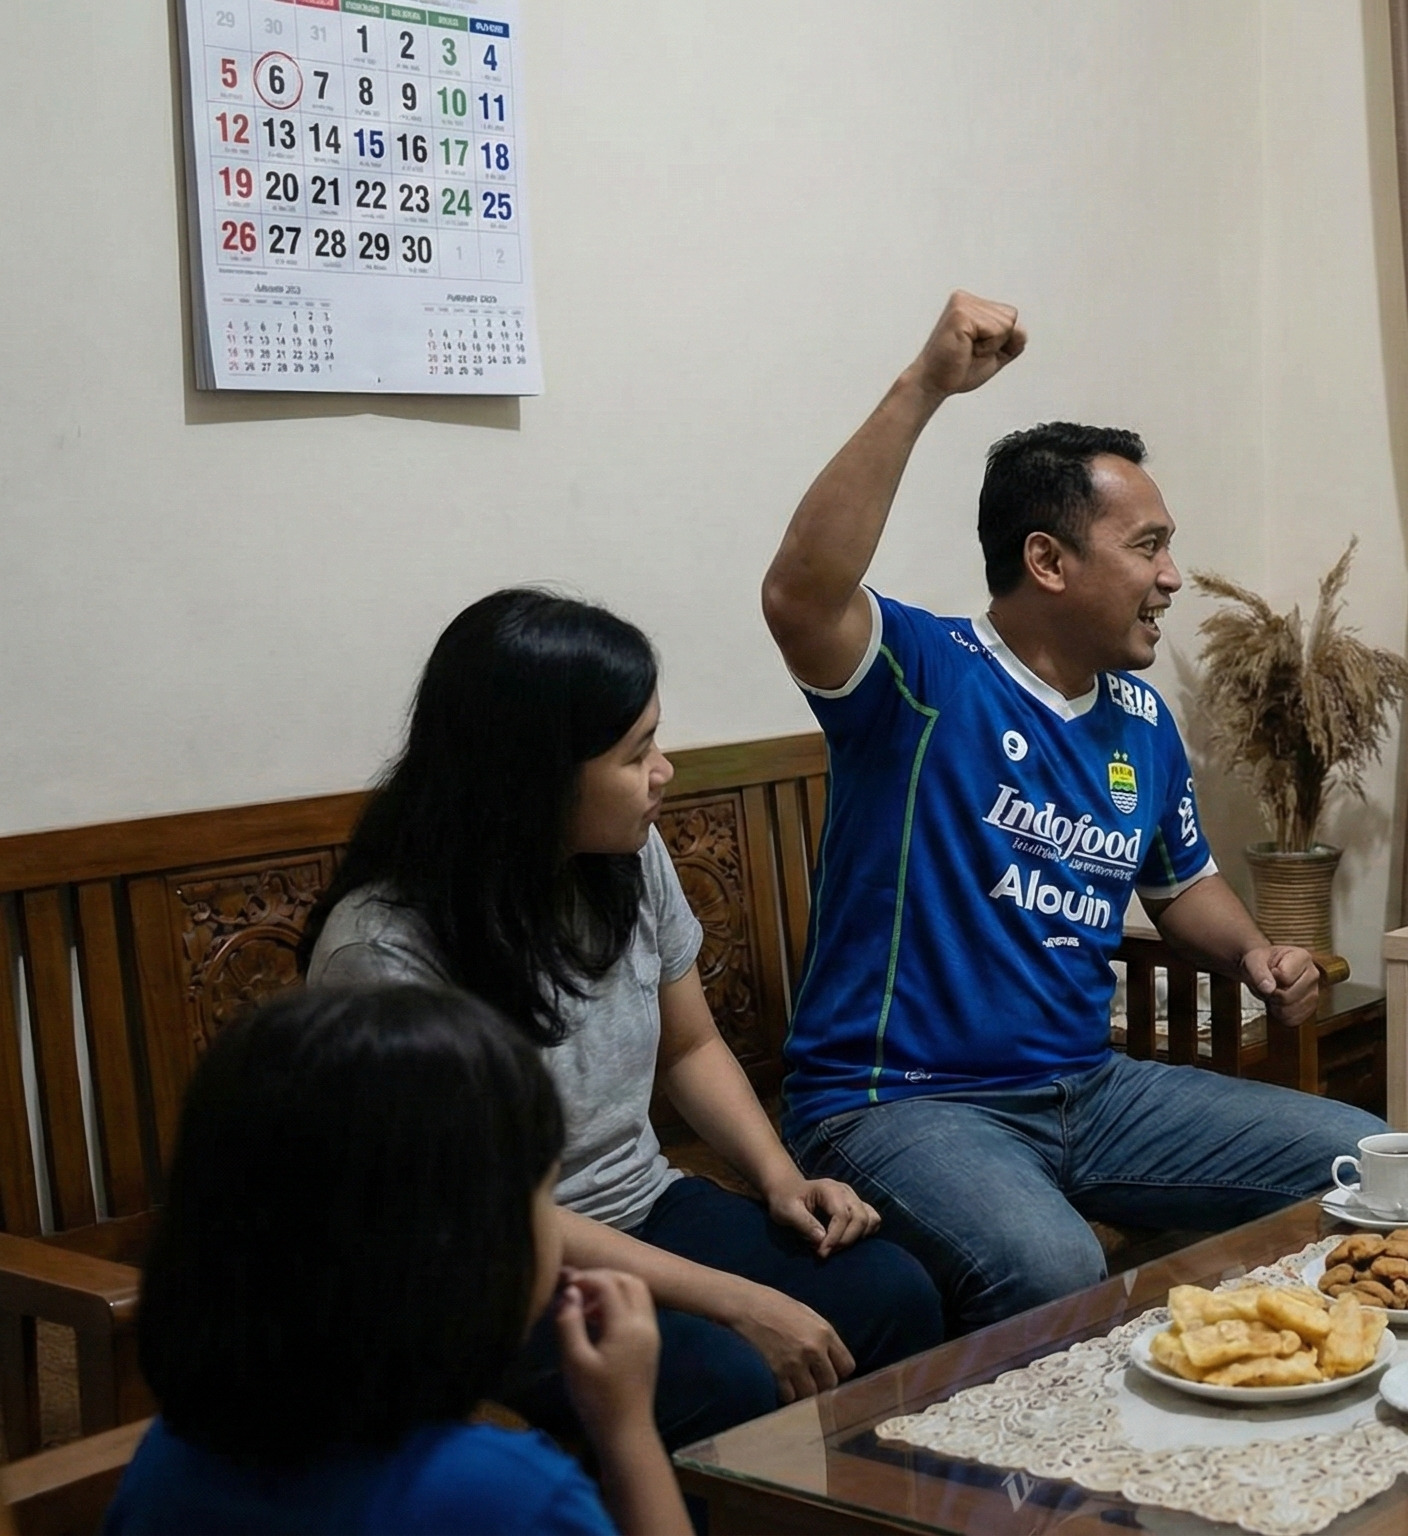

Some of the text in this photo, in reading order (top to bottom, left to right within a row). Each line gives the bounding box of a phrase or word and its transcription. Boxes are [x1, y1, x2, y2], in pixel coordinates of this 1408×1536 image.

[216, 11, 497, 70] 29 30 31 1 2 3 4
[221, 58, 505, 121] 5 6 7 8 9 10 11
[215, 111, 509, 171] 12 13 14 15 16 17 18
[219, 167, 512, 220] 19 20 21 22 23 24 25
[221, 221, 504, 264] 26 27 28 29 30 1 2
[982, 784, 1142, 862] Indofood
[989, 863, 1111, 929] Alouin
